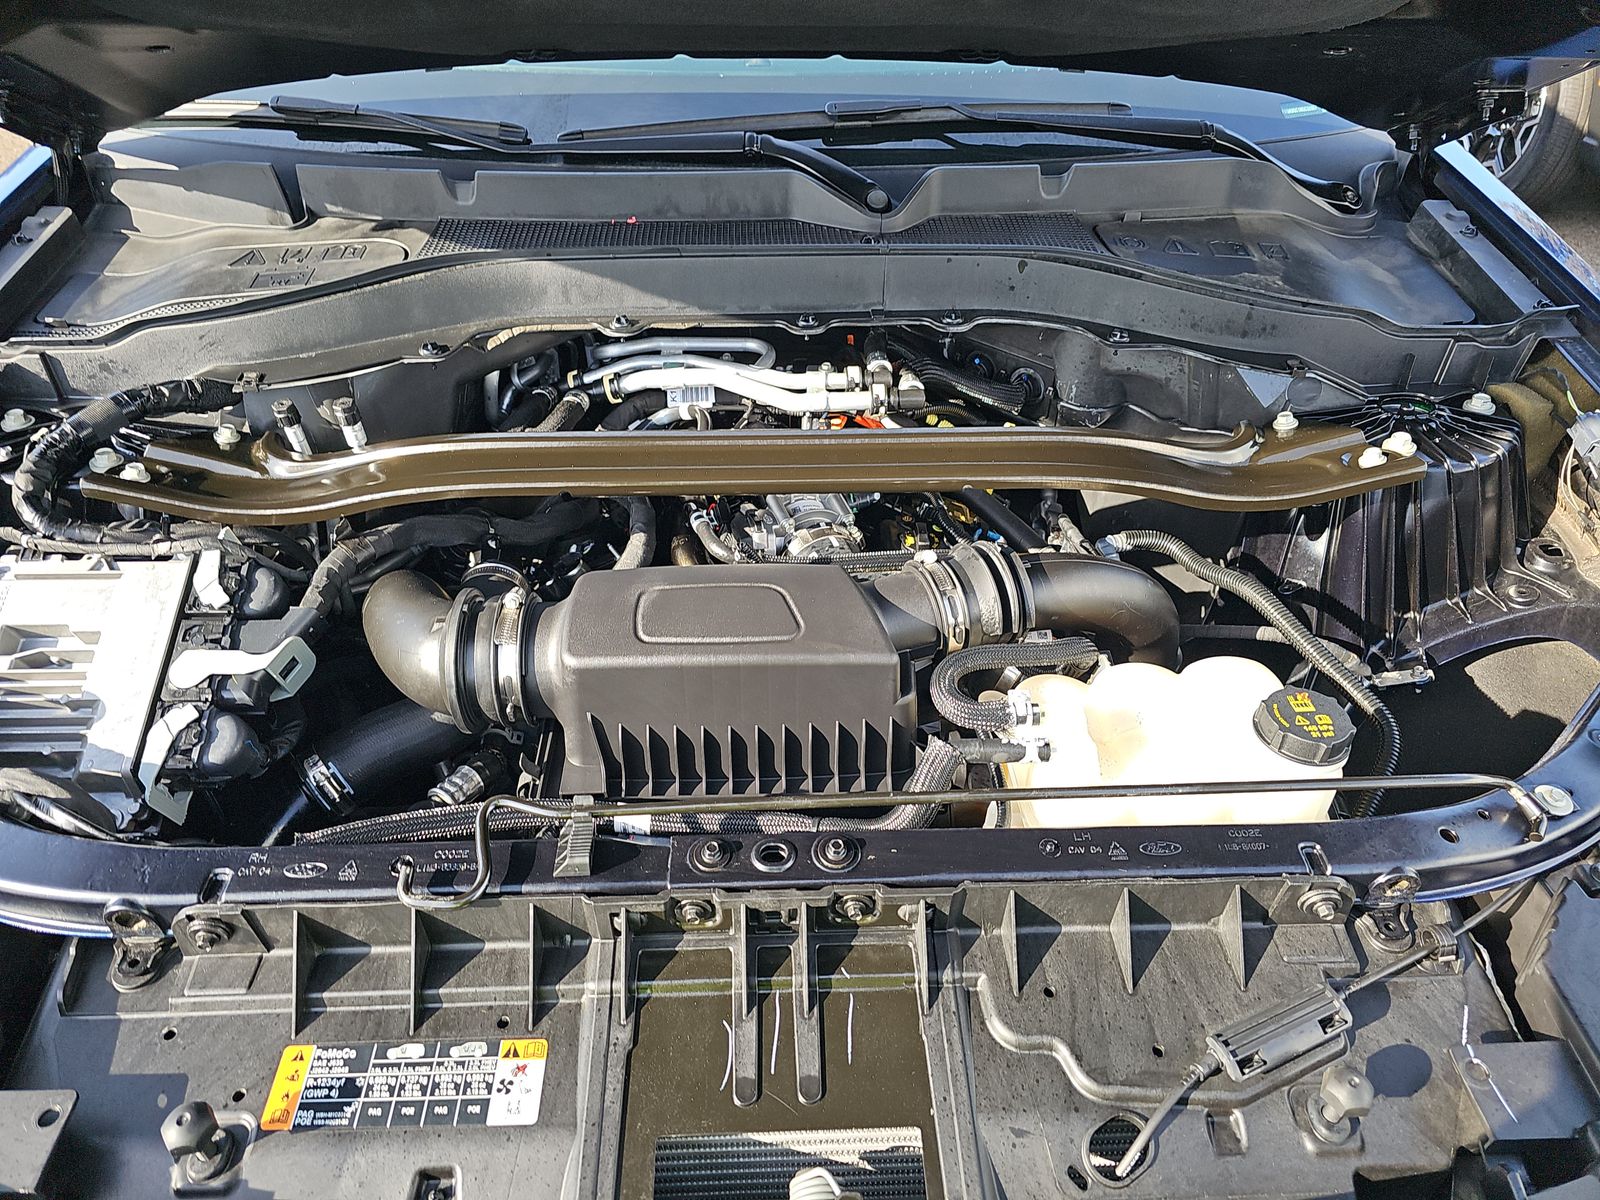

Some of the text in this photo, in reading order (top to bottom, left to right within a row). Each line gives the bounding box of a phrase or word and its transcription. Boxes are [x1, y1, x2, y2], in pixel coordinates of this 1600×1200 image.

[1073, 832, 1092, 841] LH
[315, 1048, 357, 1060] FoMoCo
[306, 1077, 346, 1088] R-1234yf
[303, 1088, 339, 1100] (GWP 4)
[297, 1110, 315, 1118] PAG
[295, 1118, 312, 1126] POE
